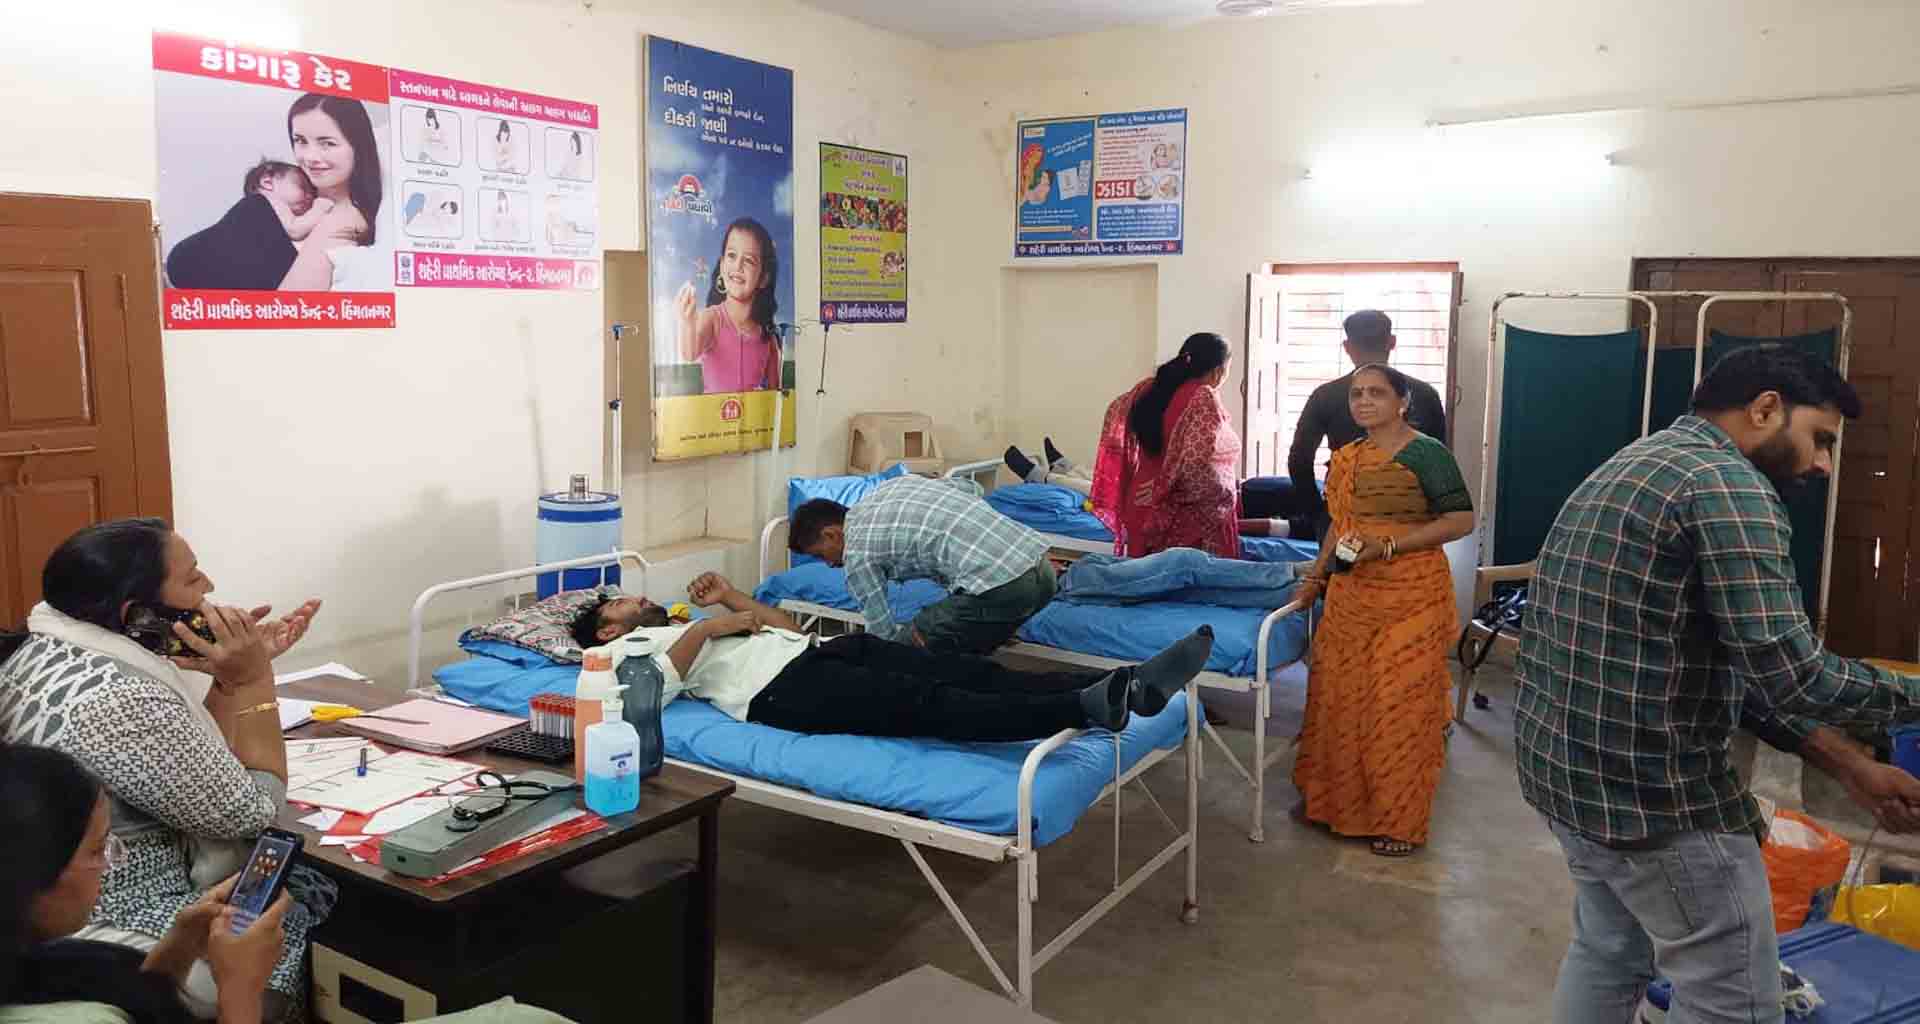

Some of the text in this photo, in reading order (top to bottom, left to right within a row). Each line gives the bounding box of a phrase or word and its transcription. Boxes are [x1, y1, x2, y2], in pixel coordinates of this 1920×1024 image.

[200, 40, 352, 91] કાંગારૂ કેર
[663, 75, 733, 105] નિર્ણય તમારો
[663, 106, 696, 129] દીકરી
[171, 297, 204, 321] શહેરી
[207, 298, 252, 321] પ્રાથમિક
[255, 298, 298, 320] આરોગ્ય
[341, 299, 391, 320] હિંમતનગર
